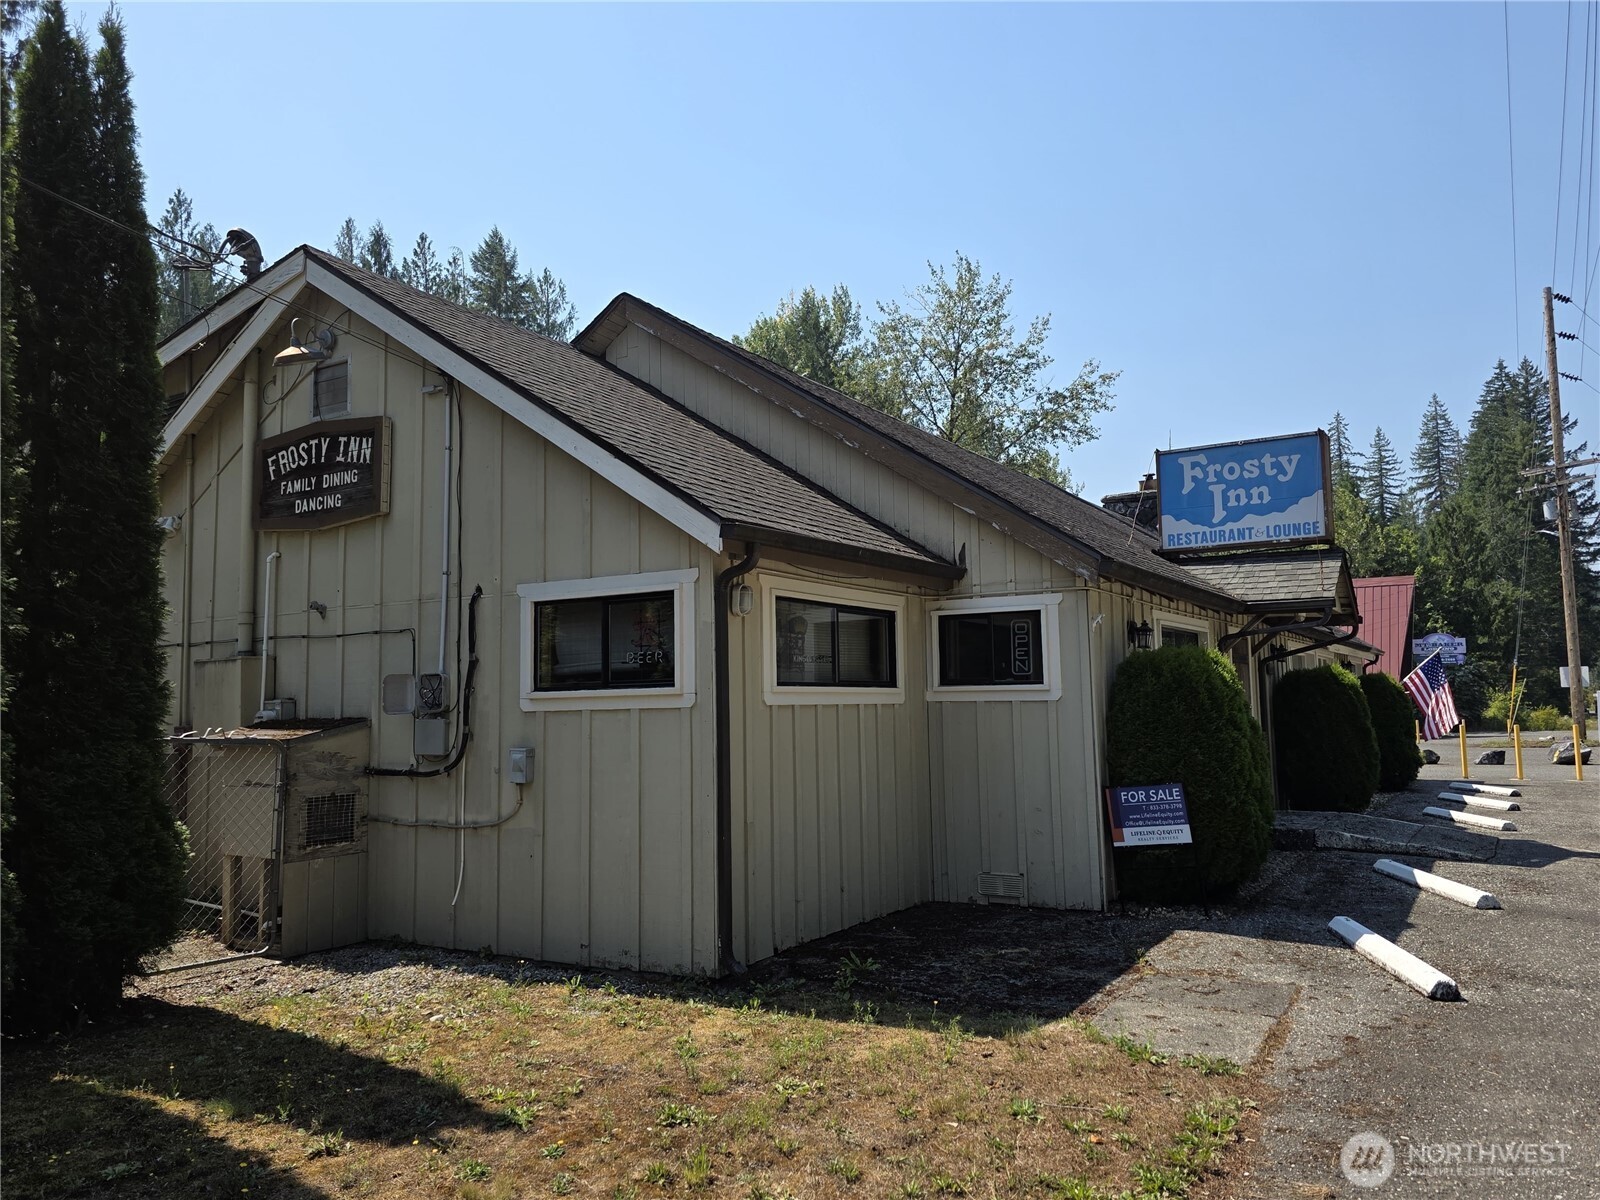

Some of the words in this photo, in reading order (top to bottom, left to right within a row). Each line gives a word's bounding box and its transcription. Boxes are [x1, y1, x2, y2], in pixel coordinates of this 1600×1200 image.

[267, 437, 330, 482] FROSTY
[336, 436, 373, 464] INN
[280, 476, 316, 495] FAMILY
[322, 469, 358, 488] DINING
[1178, 453, 1301, 495] Frosty
[295, 494, 342, 514] DANCING
[1208, 483, 1272, 524] Inn
[1167, 526, 1254, 547] RESTAURANT
[1254, 528, 1266, 538] &
[1266, 521, 1321, 539] LOUNGE
[627, 650, 664, 664] BEER
[1014, 623, 1029, 672] OPEN
[1121, 791, 1147, 803] FOR
[1149, 788, 1181, 801] SALE
